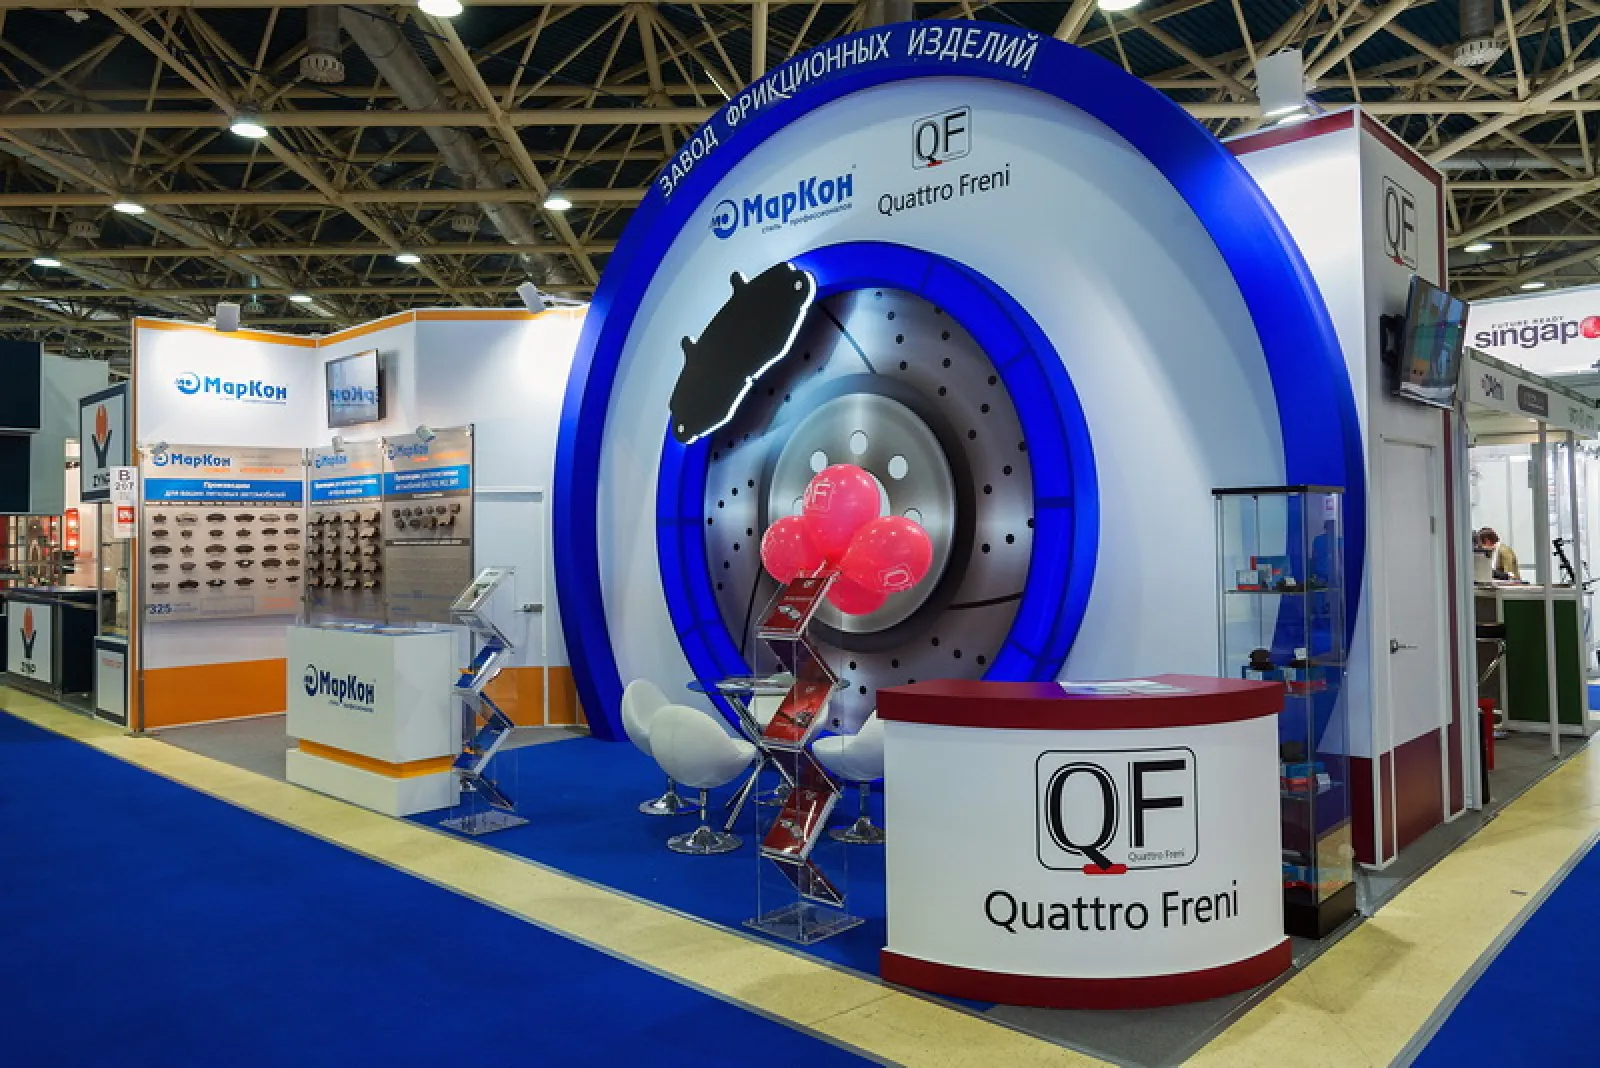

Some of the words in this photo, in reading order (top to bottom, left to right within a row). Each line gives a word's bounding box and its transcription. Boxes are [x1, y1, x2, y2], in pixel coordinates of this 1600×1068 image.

[659, 125, 719, 198] ЗАВОД
[725, 31, 892, 126] ФРИКЦИОННЫХ
[907, 27, 1040, 72] ИЗДЕЛИЙ
[915, 111, 967, 164] QF
[743, 173, 853, 228] МарКон
[877, 183, 953, 216] Quattro
[959, 162, 1011, 197] Freni
[1385, 186, 1415, 257] QF
[203, 376, 287, 400] МарКон
[171, 453, 231, 468] МарКон
[319, 670, 375, 705] МарКон
[1044, 758, 1187, 870] QF
[1127, 851, 1163, 863] Quattro
[1165, 848, 1185, 859] Freni
[984, 889, 1149, 935] Quattro
[1161, 879, 1239, 929] Freni
